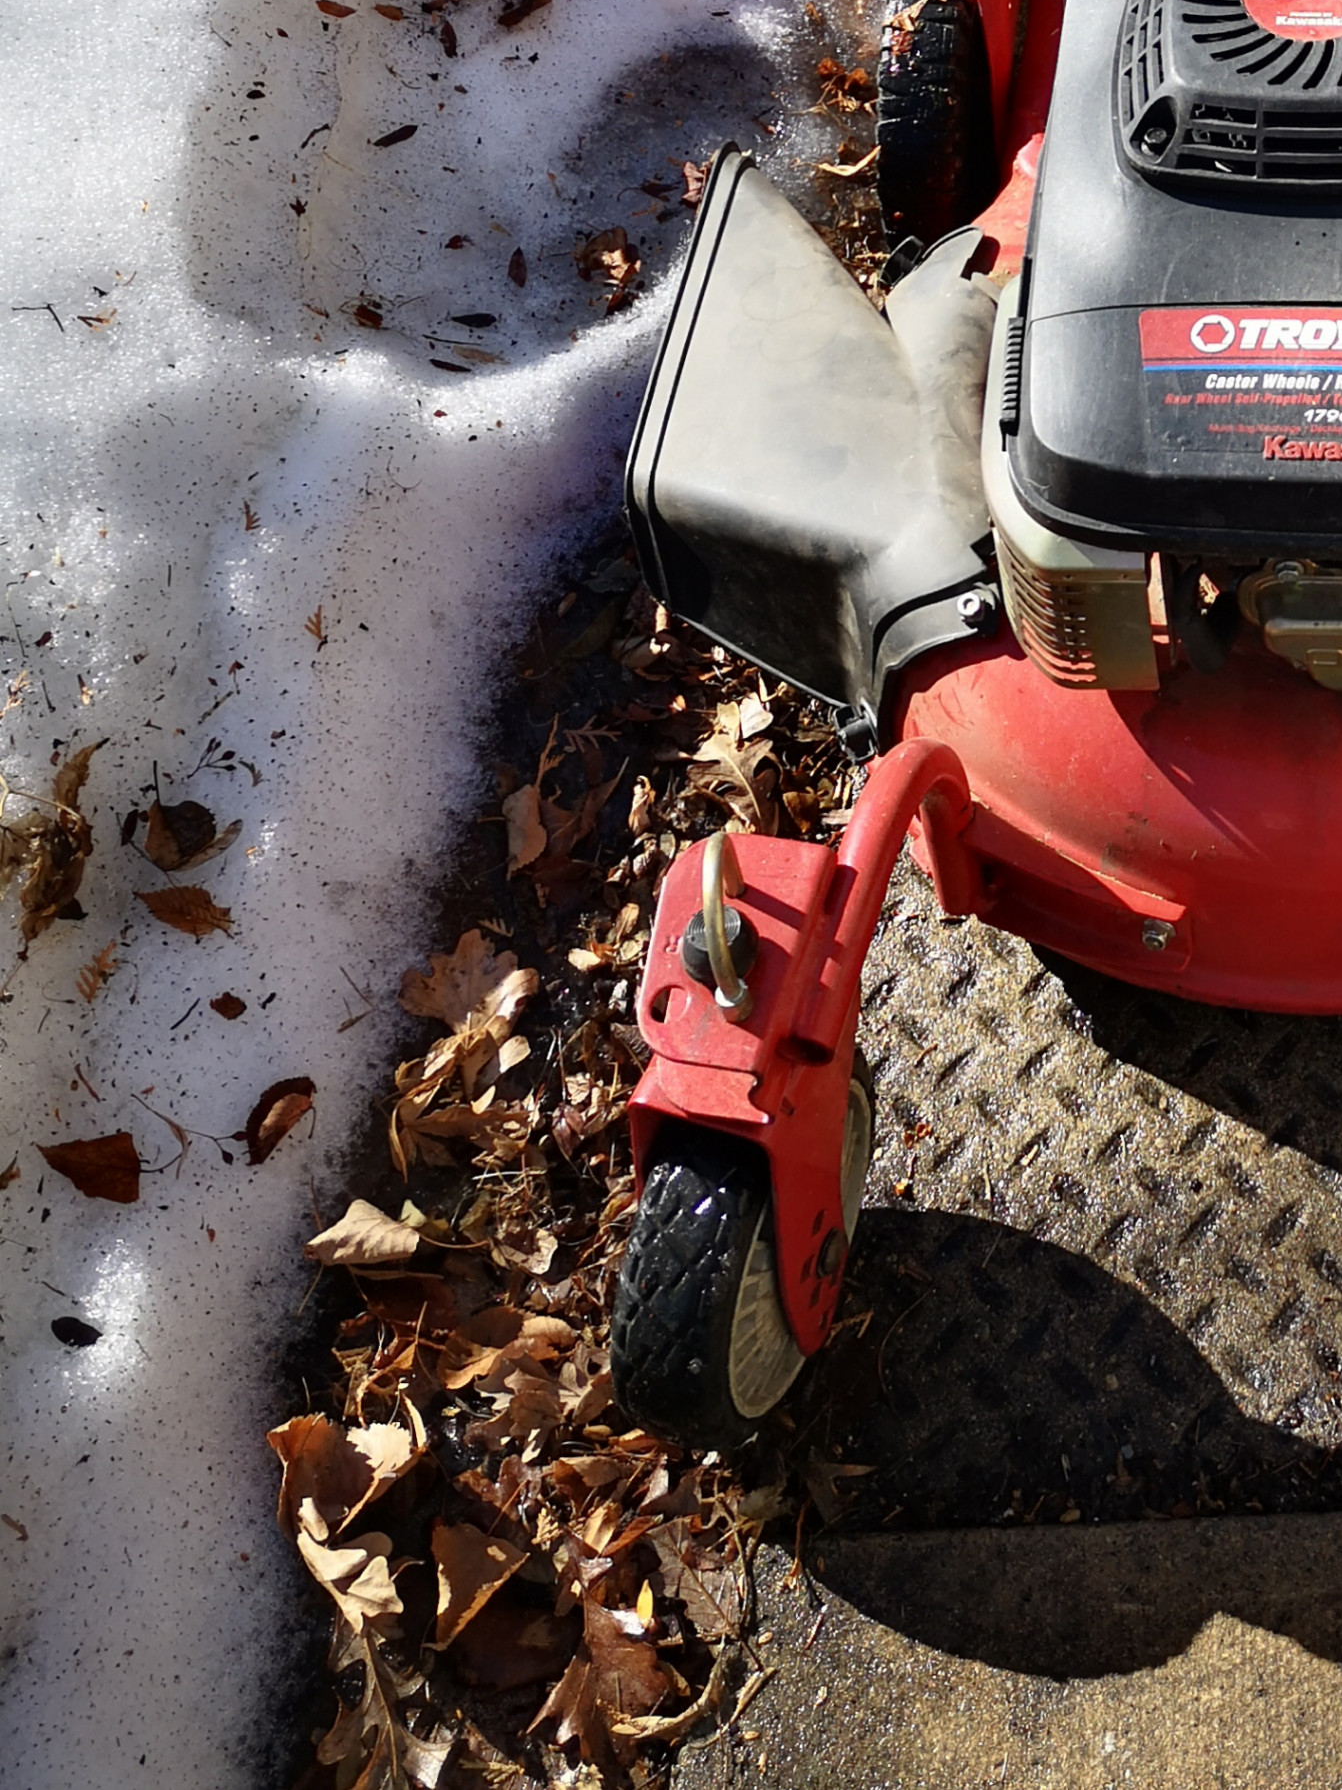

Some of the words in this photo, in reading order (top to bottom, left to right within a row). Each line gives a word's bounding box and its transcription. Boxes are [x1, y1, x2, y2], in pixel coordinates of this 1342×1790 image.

[1204, 373, 1259, 390] Caster
[1262, 373, 1321, 390] Wheels
[1163, 393, 1192, 405] Rear
[1195, 393, 1232, 405] Wheel
